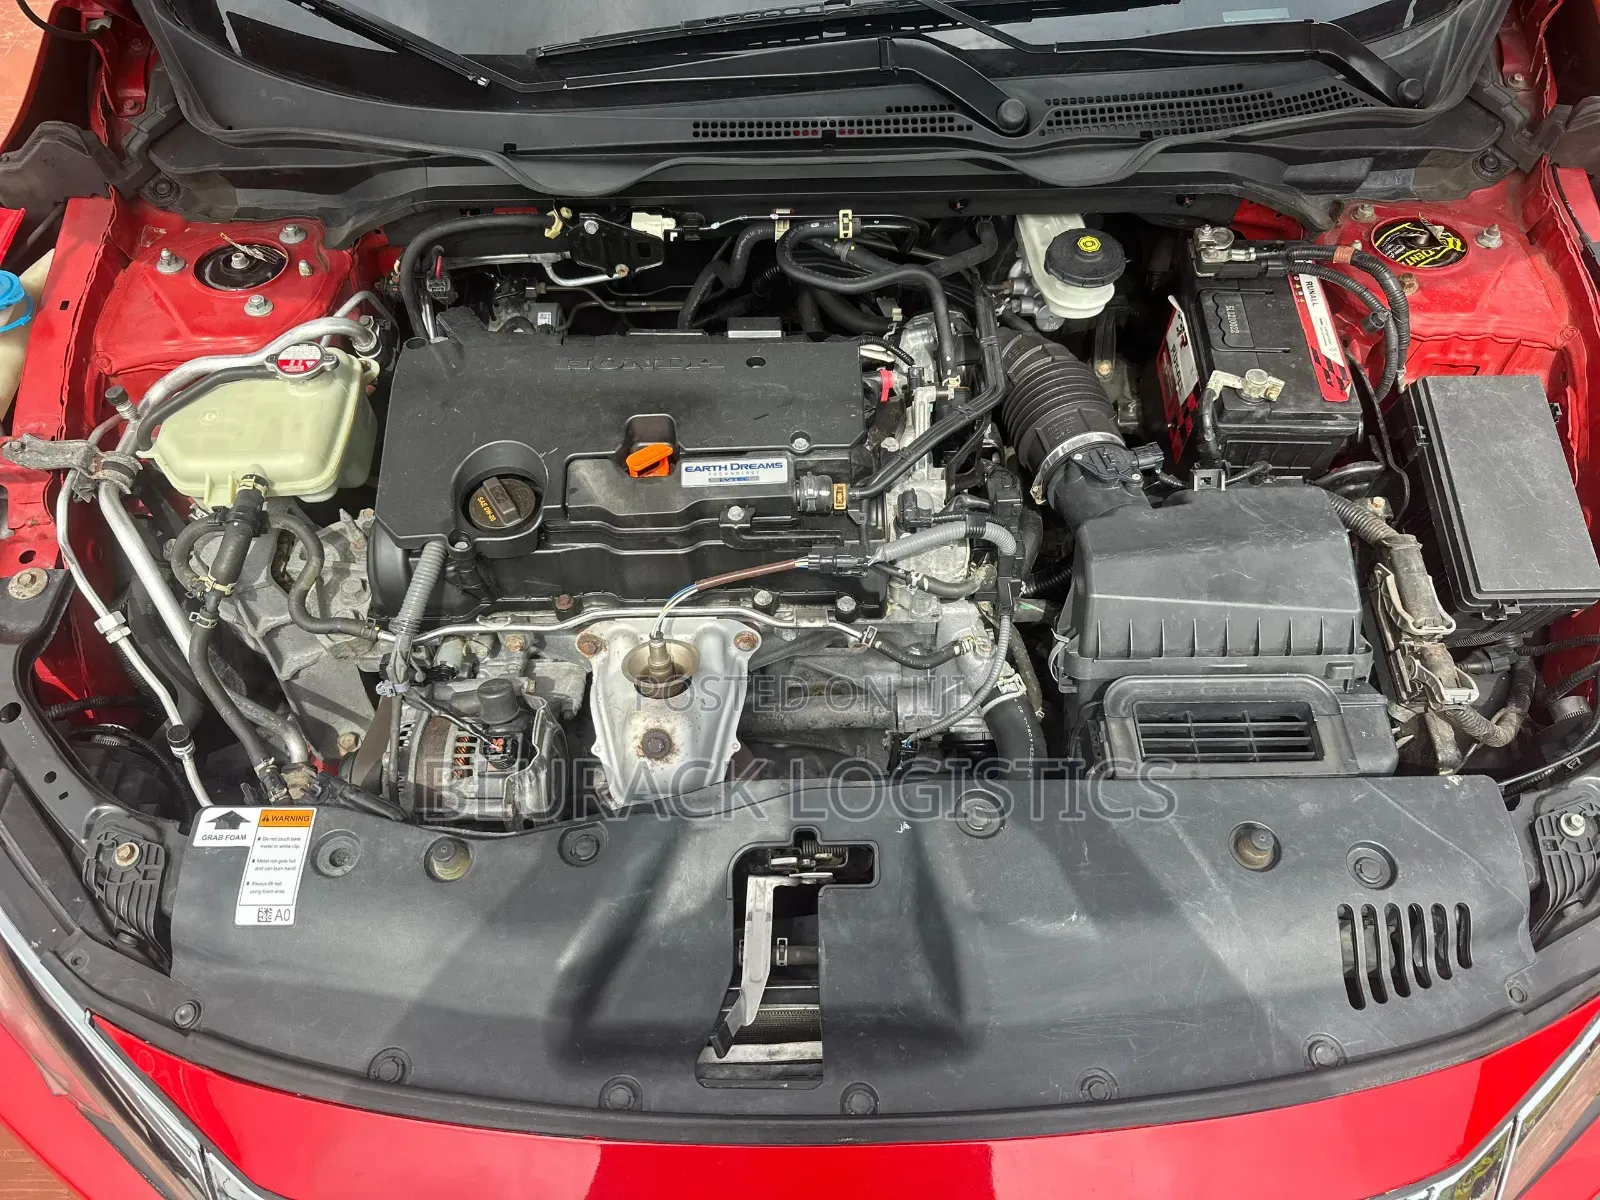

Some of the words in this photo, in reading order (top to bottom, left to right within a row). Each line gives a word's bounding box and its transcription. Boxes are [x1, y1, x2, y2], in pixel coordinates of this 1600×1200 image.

[1305, 281, 1317, 307] RUNALL
[554, 357, 726, 371] HONDA
[684, 465, 728, 473] EARTH
[730, 462, 783, 471] DREAMS
[477, 496, 488, 509] SAE
[273, 908, 291, 922] A0
